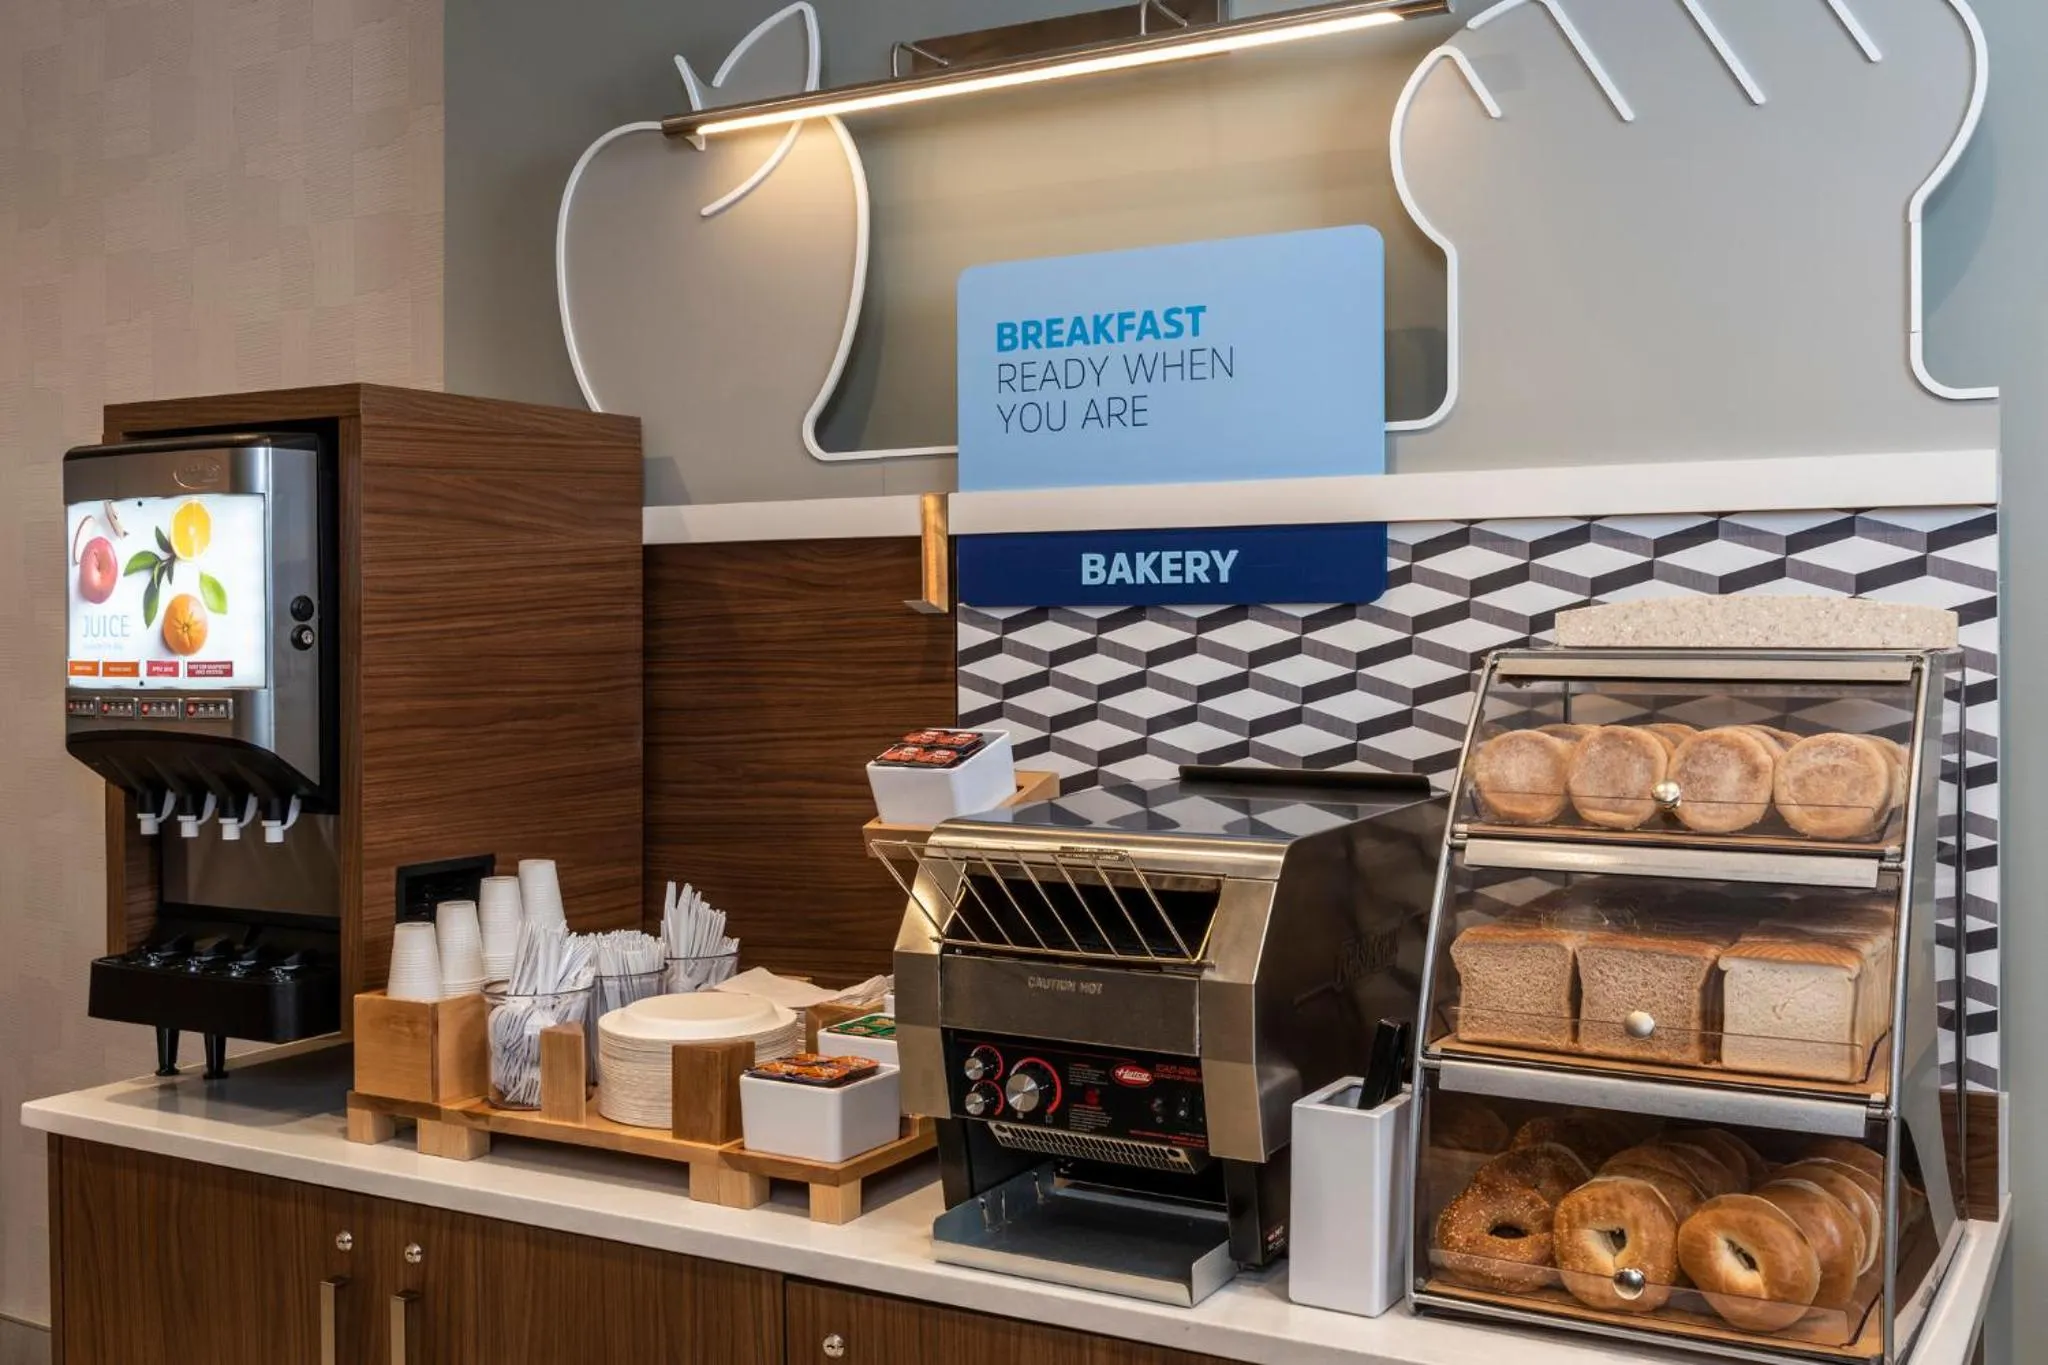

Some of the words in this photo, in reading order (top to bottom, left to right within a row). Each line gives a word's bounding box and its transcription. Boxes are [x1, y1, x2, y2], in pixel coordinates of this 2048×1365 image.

[996, 305, 1207, 353] BREAKFAST
[997, 355, 1109, 394] READY
[1123, 346, 1234, 385] WHEN
[996, 400, 1067, 434] YOU
[1081, 395, 1149, 429] ARE
[1081, 549, 1240, 586] BAKERY
[82, 614, 132, 638] JUICE
[1027, 975, 1077, 992] CAUTION
[1079, 980, 1104, 995] HOT
